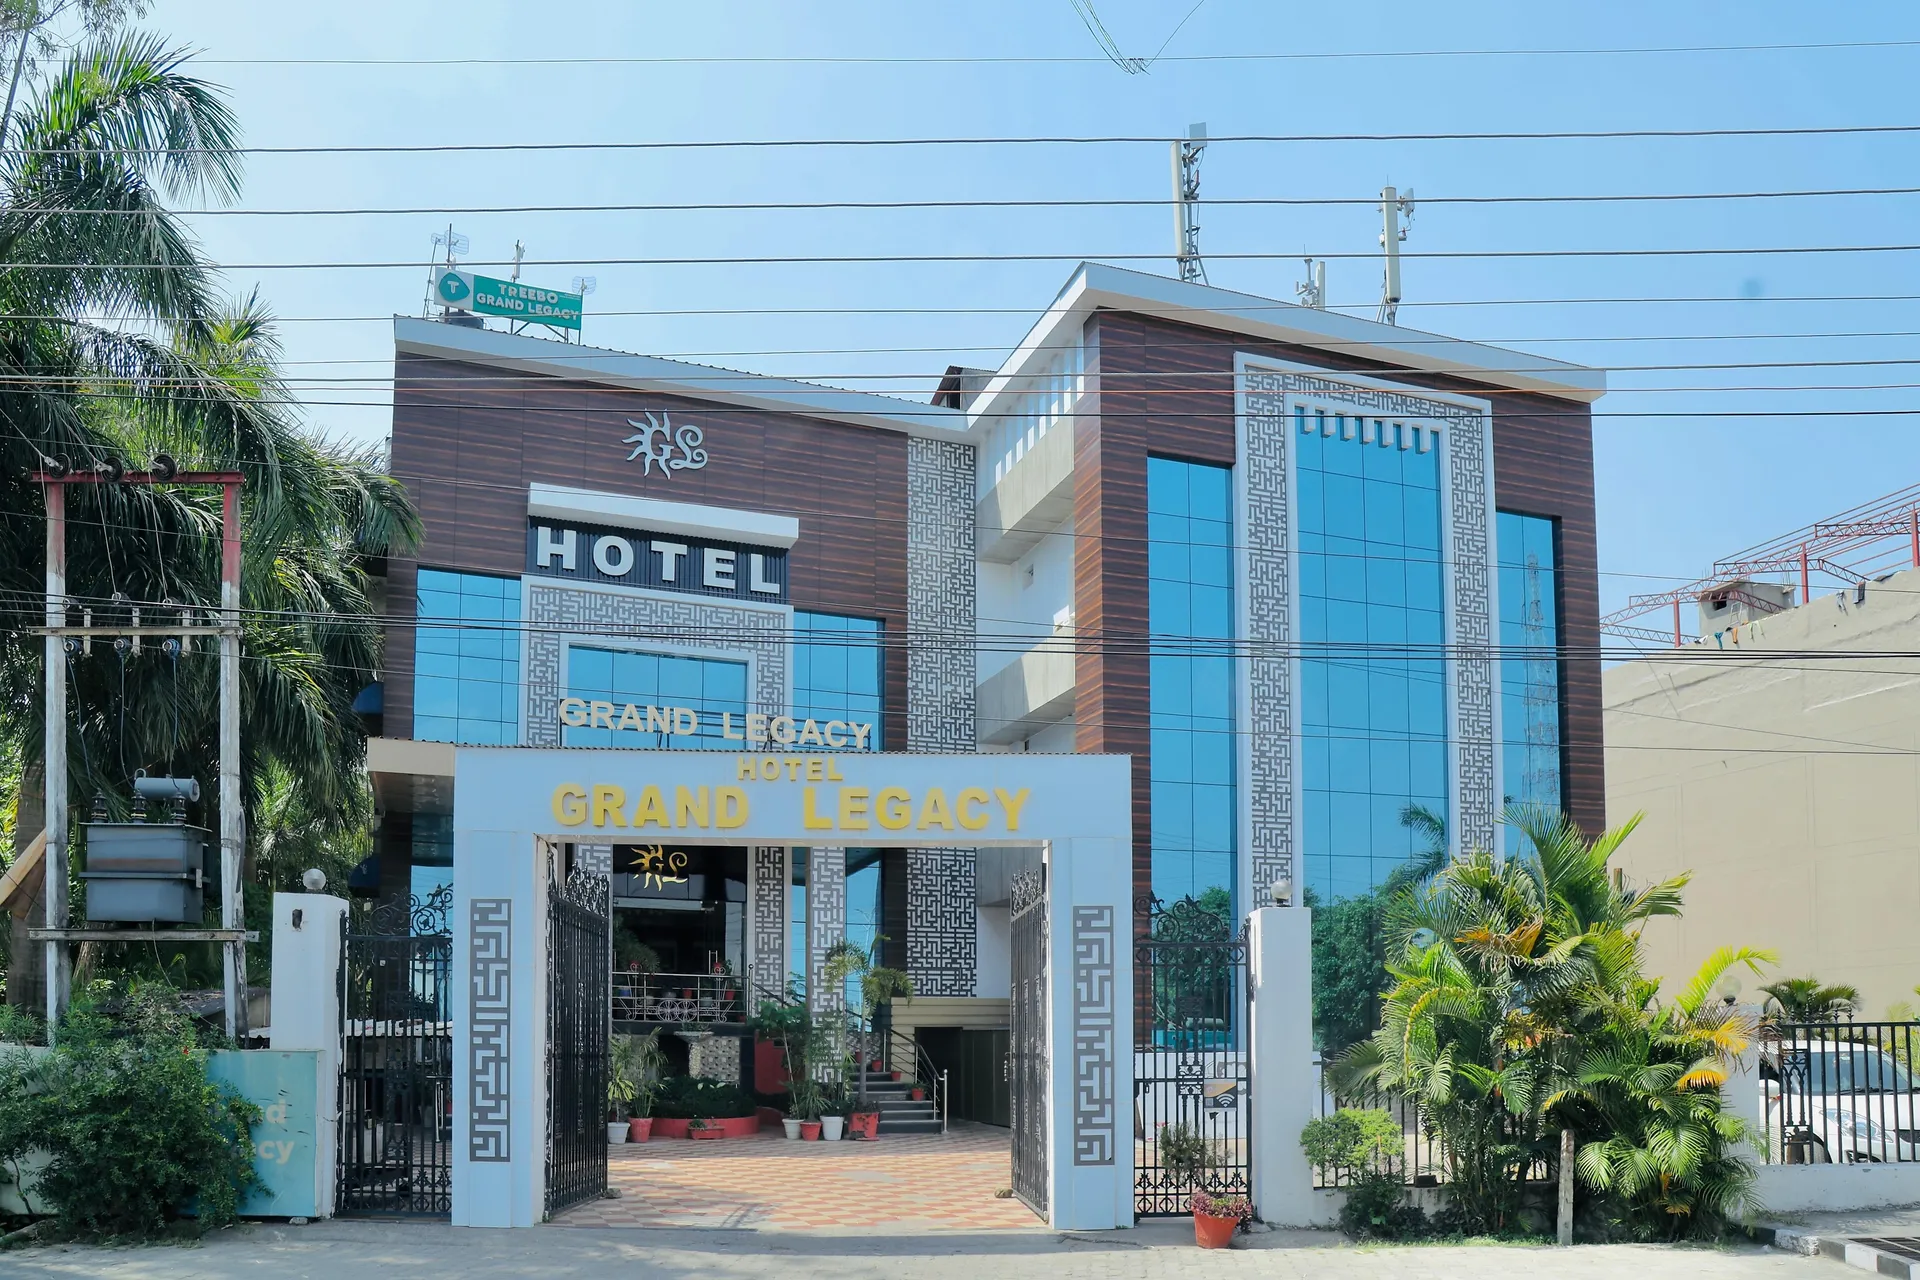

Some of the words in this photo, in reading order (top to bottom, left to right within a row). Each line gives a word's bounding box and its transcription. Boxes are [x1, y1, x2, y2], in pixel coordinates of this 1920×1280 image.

[476, 292, 524, 311] GRAND
[528, 302, 580, 321] LEGACY
[498, 283, 558, 304] TREEBO
[536, 526, 780, 594] HOTEL
[559, 698, 698, 736] GRAND
[722, 712, 872, 749] LEGACY
[737, 757, 843, 781] HOTEL
[551, 783, 749, 829] GRAND
[803, 786, 1031, 831] LEGACY
